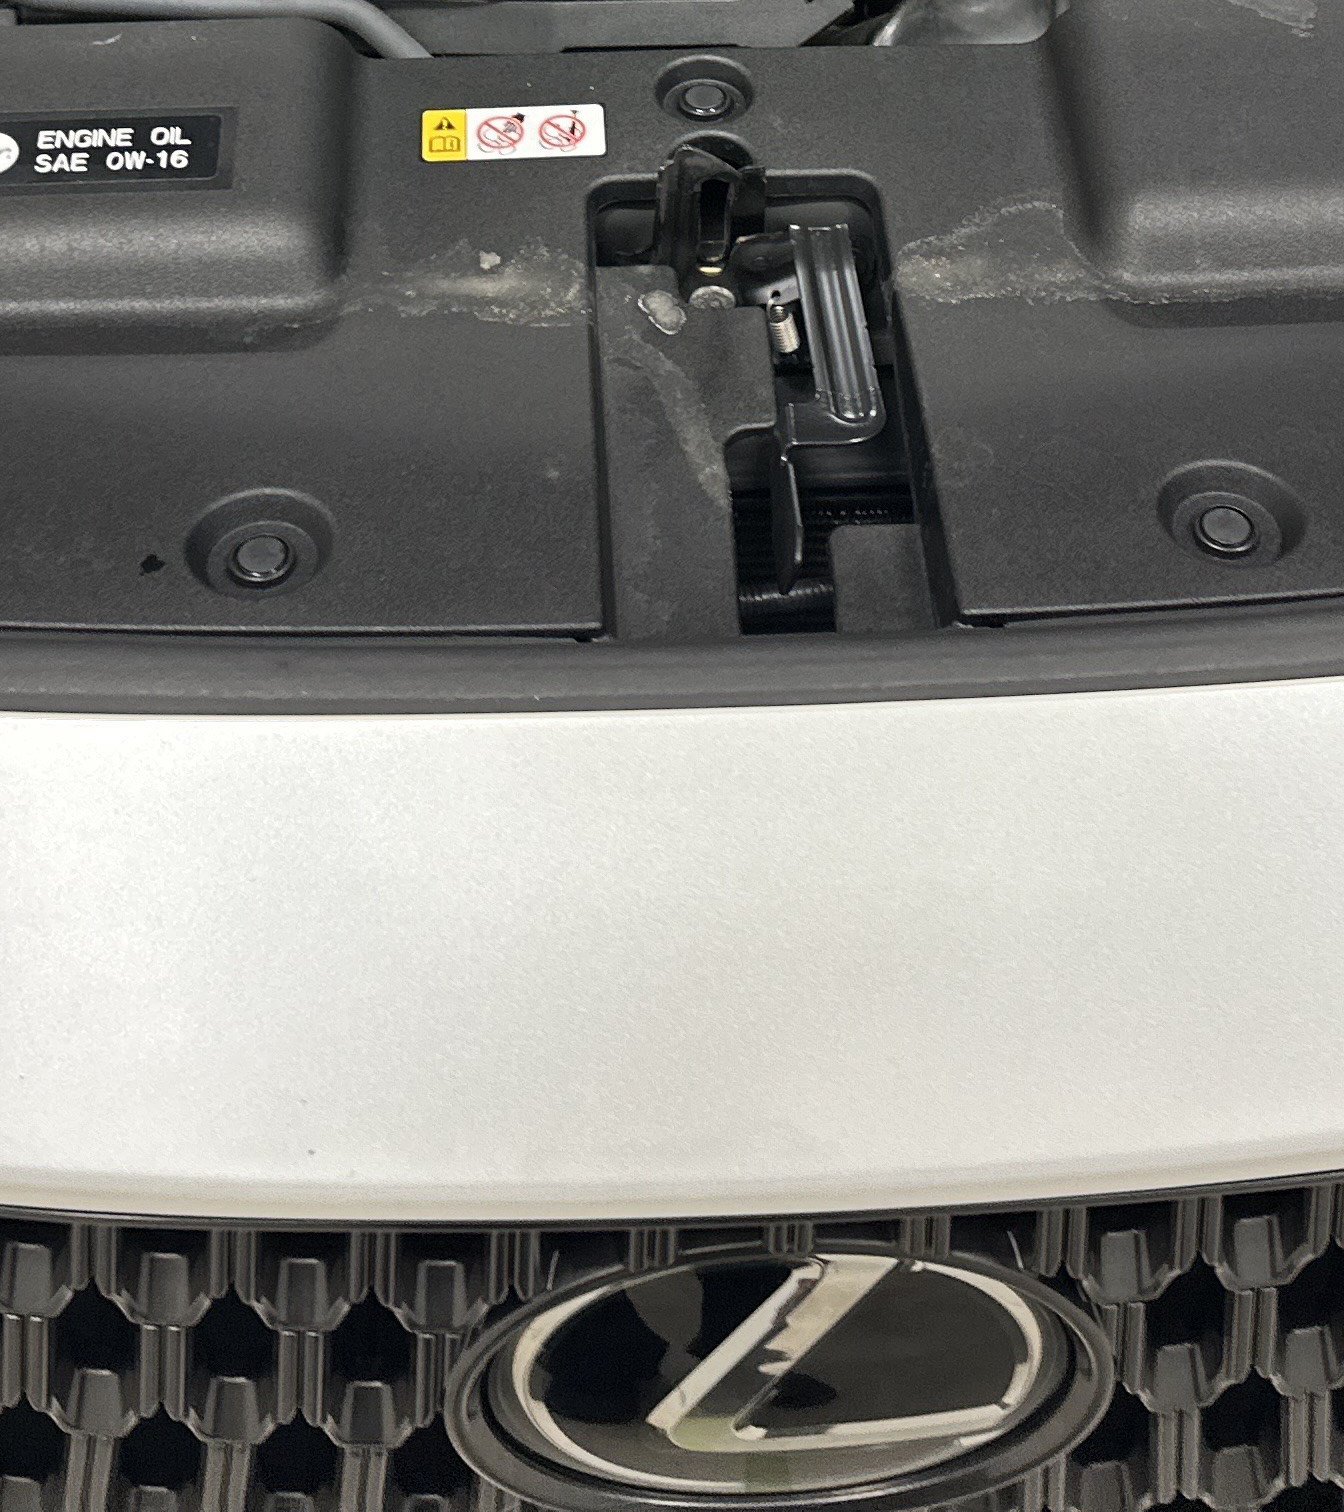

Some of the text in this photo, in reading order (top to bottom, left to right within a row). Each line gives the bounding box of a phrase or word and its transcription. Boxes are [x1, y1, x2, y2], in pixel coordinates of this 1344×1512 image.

[36, 126, 192, 150] ENGINE OIL
[33, 152, 90, 174] SAE
